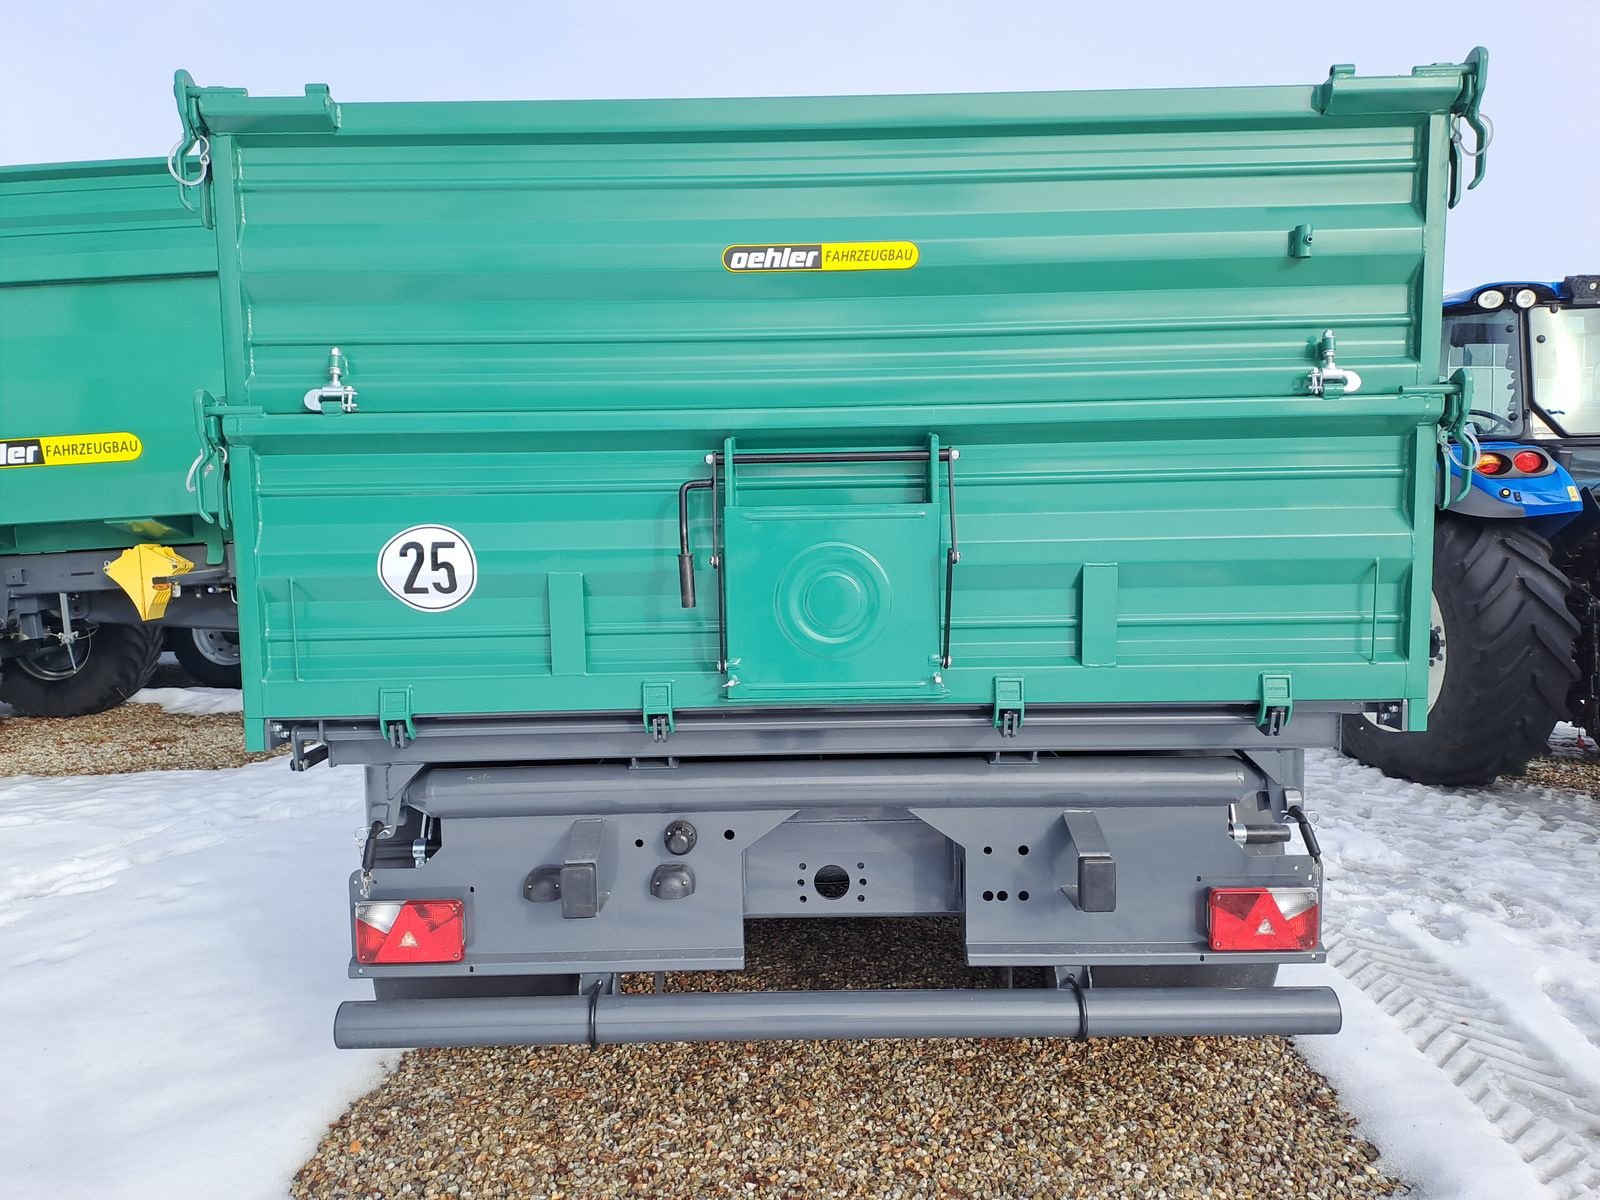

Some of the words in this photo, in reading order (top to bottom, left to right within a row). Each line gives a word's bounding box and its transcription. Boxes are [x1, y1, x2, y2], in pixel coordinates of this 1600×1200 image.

[730, 247, 819, 269] oehler
[825, 249, 913, 263] FAHRZEUGBAU
[45, 440, 138, 457] FAHRZEUGBAU
[399, 541, 458, 594] 25
